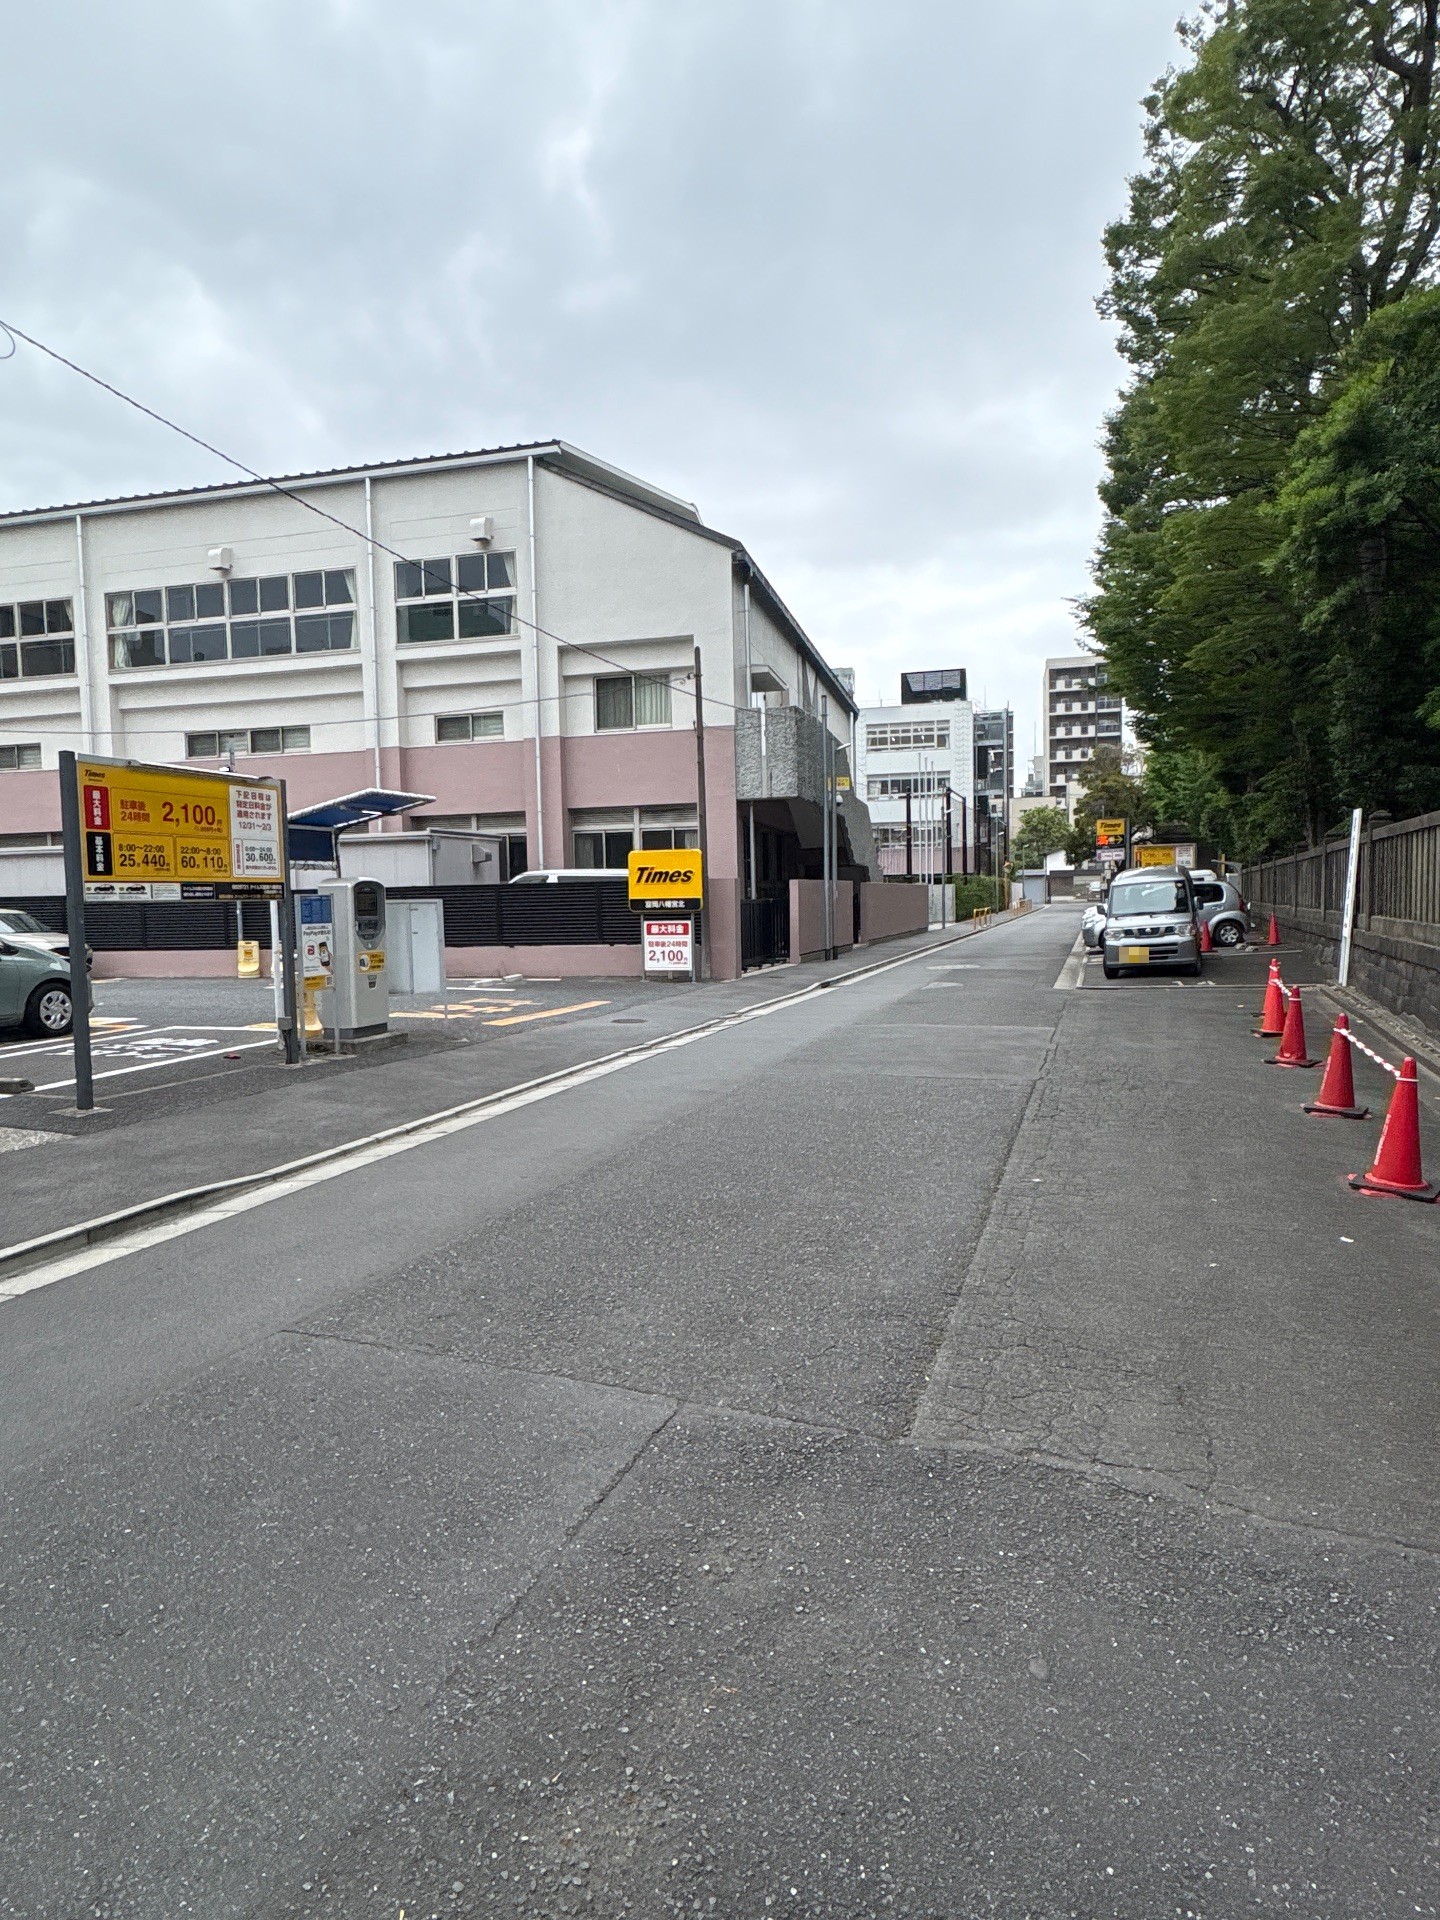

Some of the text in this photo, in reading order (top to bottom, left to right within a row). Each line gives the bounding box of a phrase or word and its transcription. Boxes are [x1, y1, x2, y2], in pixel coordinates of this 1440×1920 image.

[84, 769, 105, 779] Times
[120, 811, 150, 823] 24時間
[636, 866, 694, 884] Times
[650, 924, 684, 934] 最大料金
